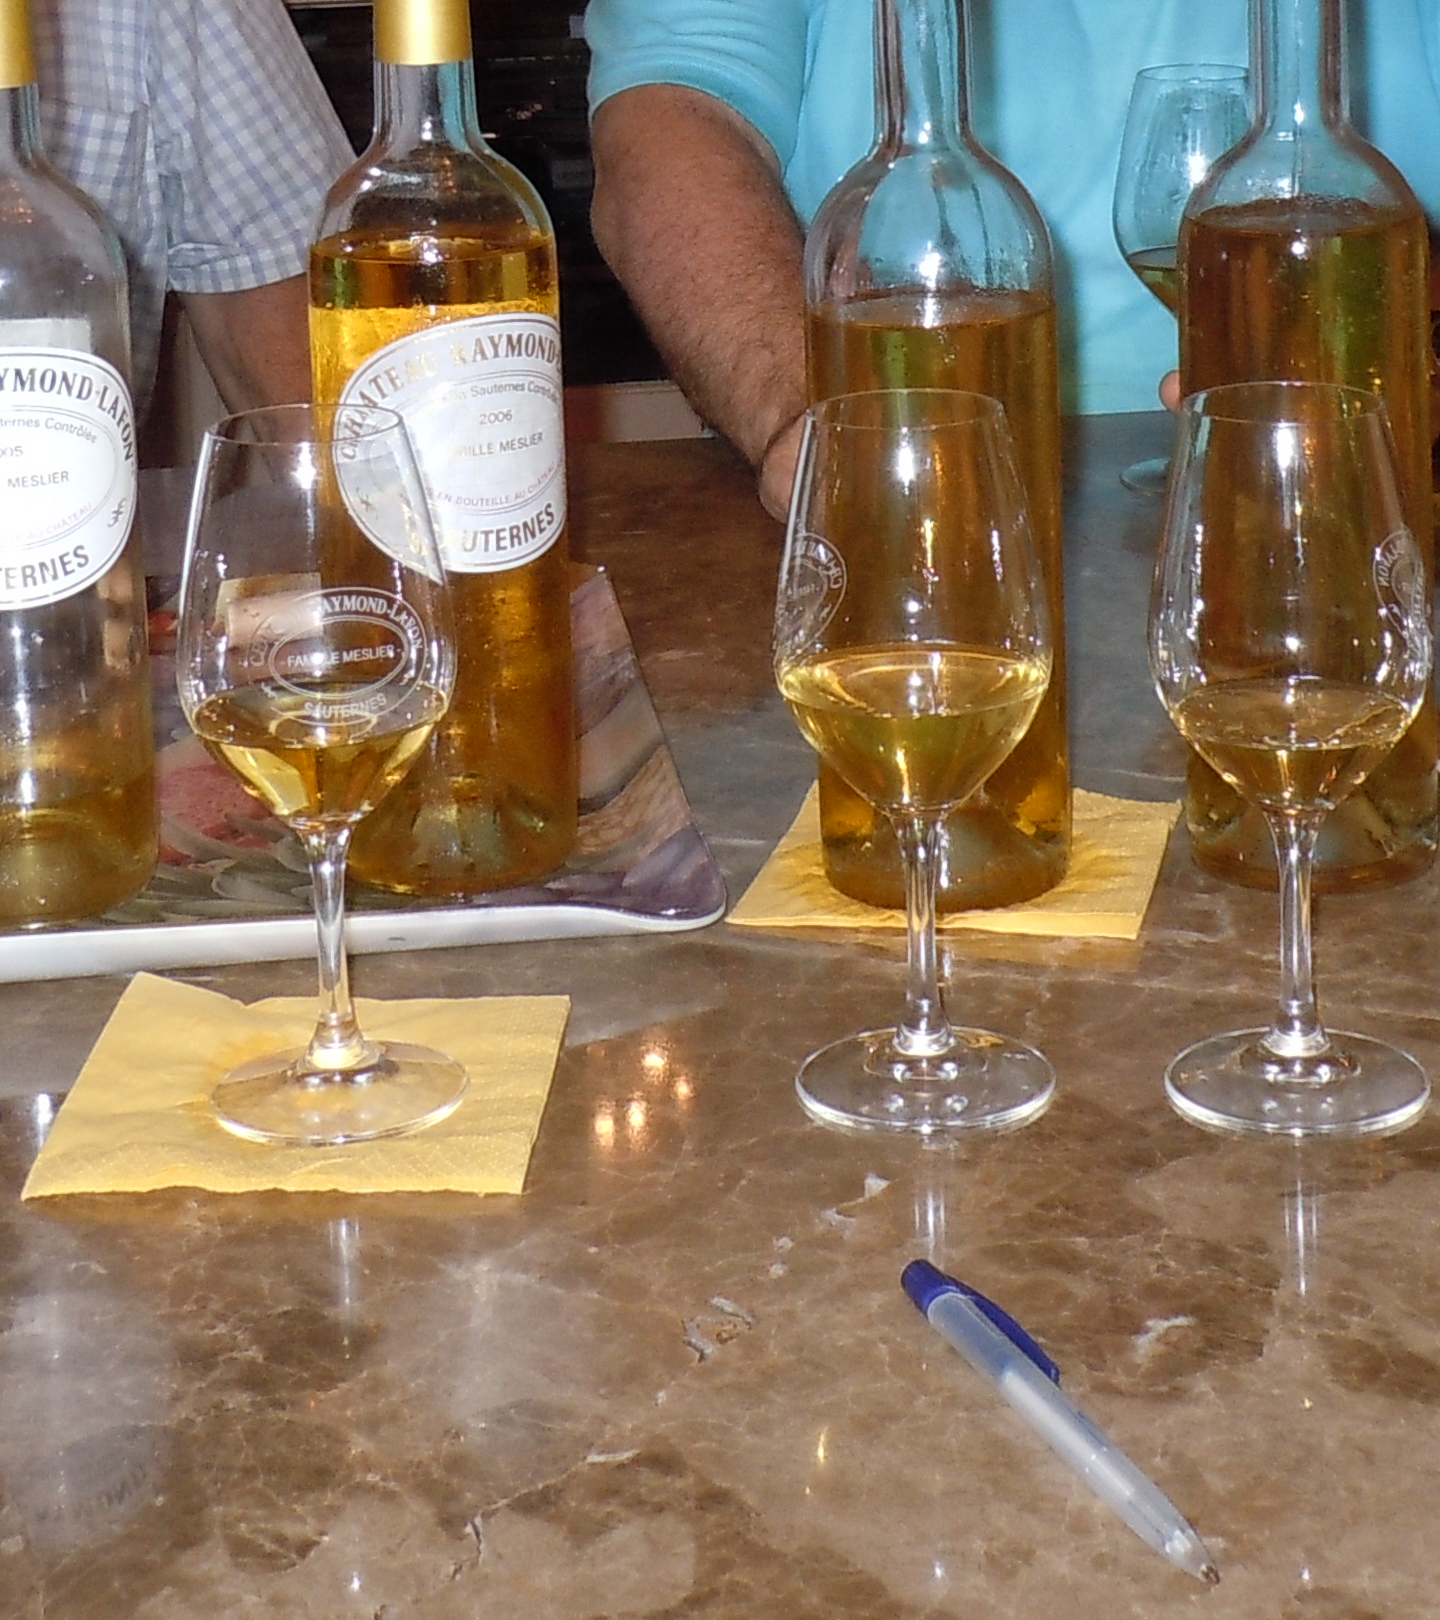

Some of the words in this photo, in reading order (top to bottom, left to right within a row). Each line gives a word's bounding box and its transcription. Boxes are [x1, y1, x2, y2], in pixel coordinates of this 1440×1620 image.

[479, 409, 513, 426] 2006
[44, 417, 99, 445] Contrôlée
[499, 432, 544, 453] MESLIER
[7, 470, 70, 490] MESLIER
[318, 594, 424, 650] AYMOND-LAFON
[342, 644, 395, 663] MESLIER
